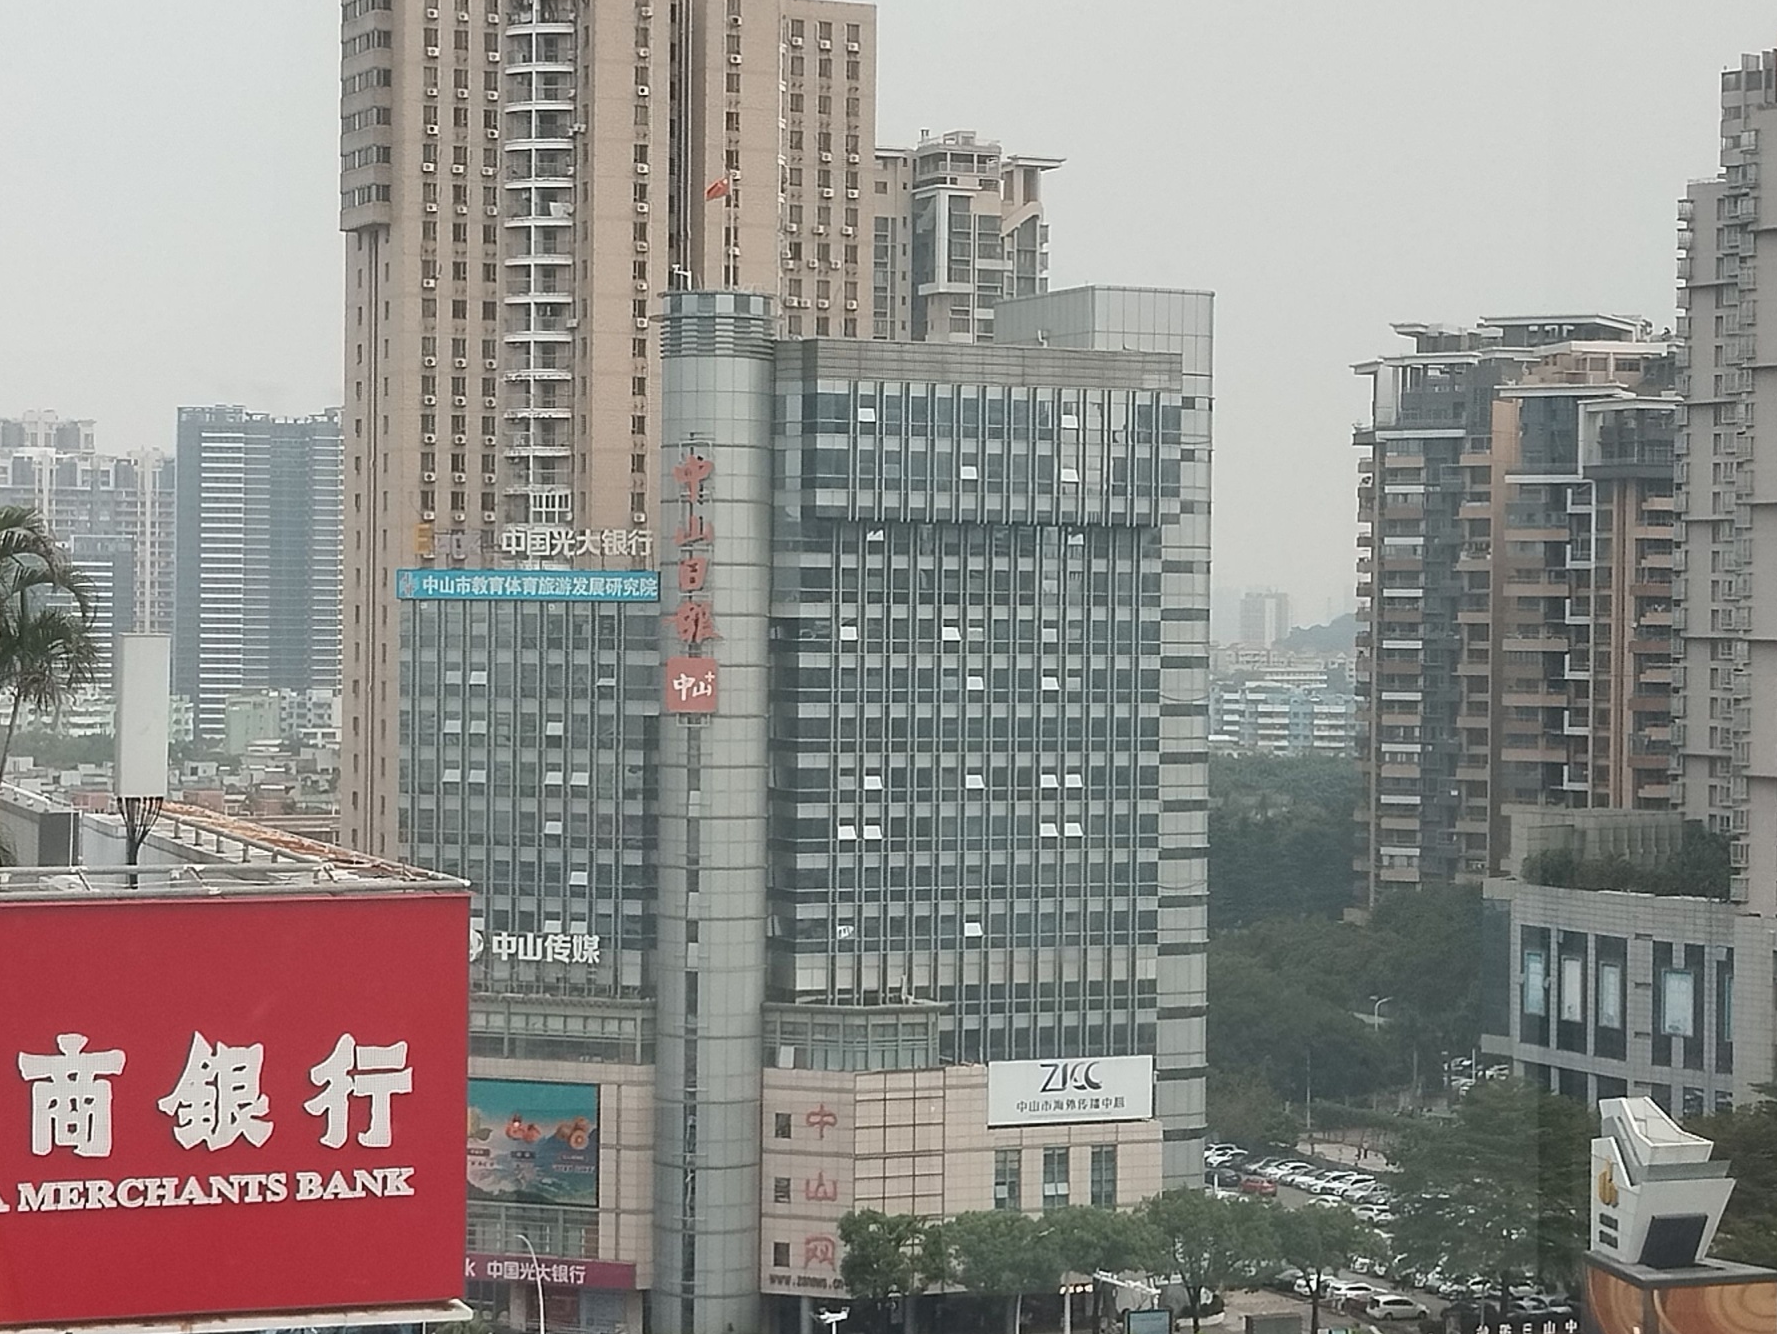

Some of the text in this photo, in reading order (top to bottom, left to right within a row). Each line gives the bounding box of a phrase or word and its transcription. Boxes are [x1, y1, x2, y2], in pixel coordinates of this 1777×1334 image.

[501, 528, 653, 556] 中国光大银行
[492, 932, 600, 964] 中山传媒
[17, 1171, 288, 1212] MERCHANTS
[295, 1167, 415, 1201] BANK
[487, 1259, 587, 1284] 中国光大银行
